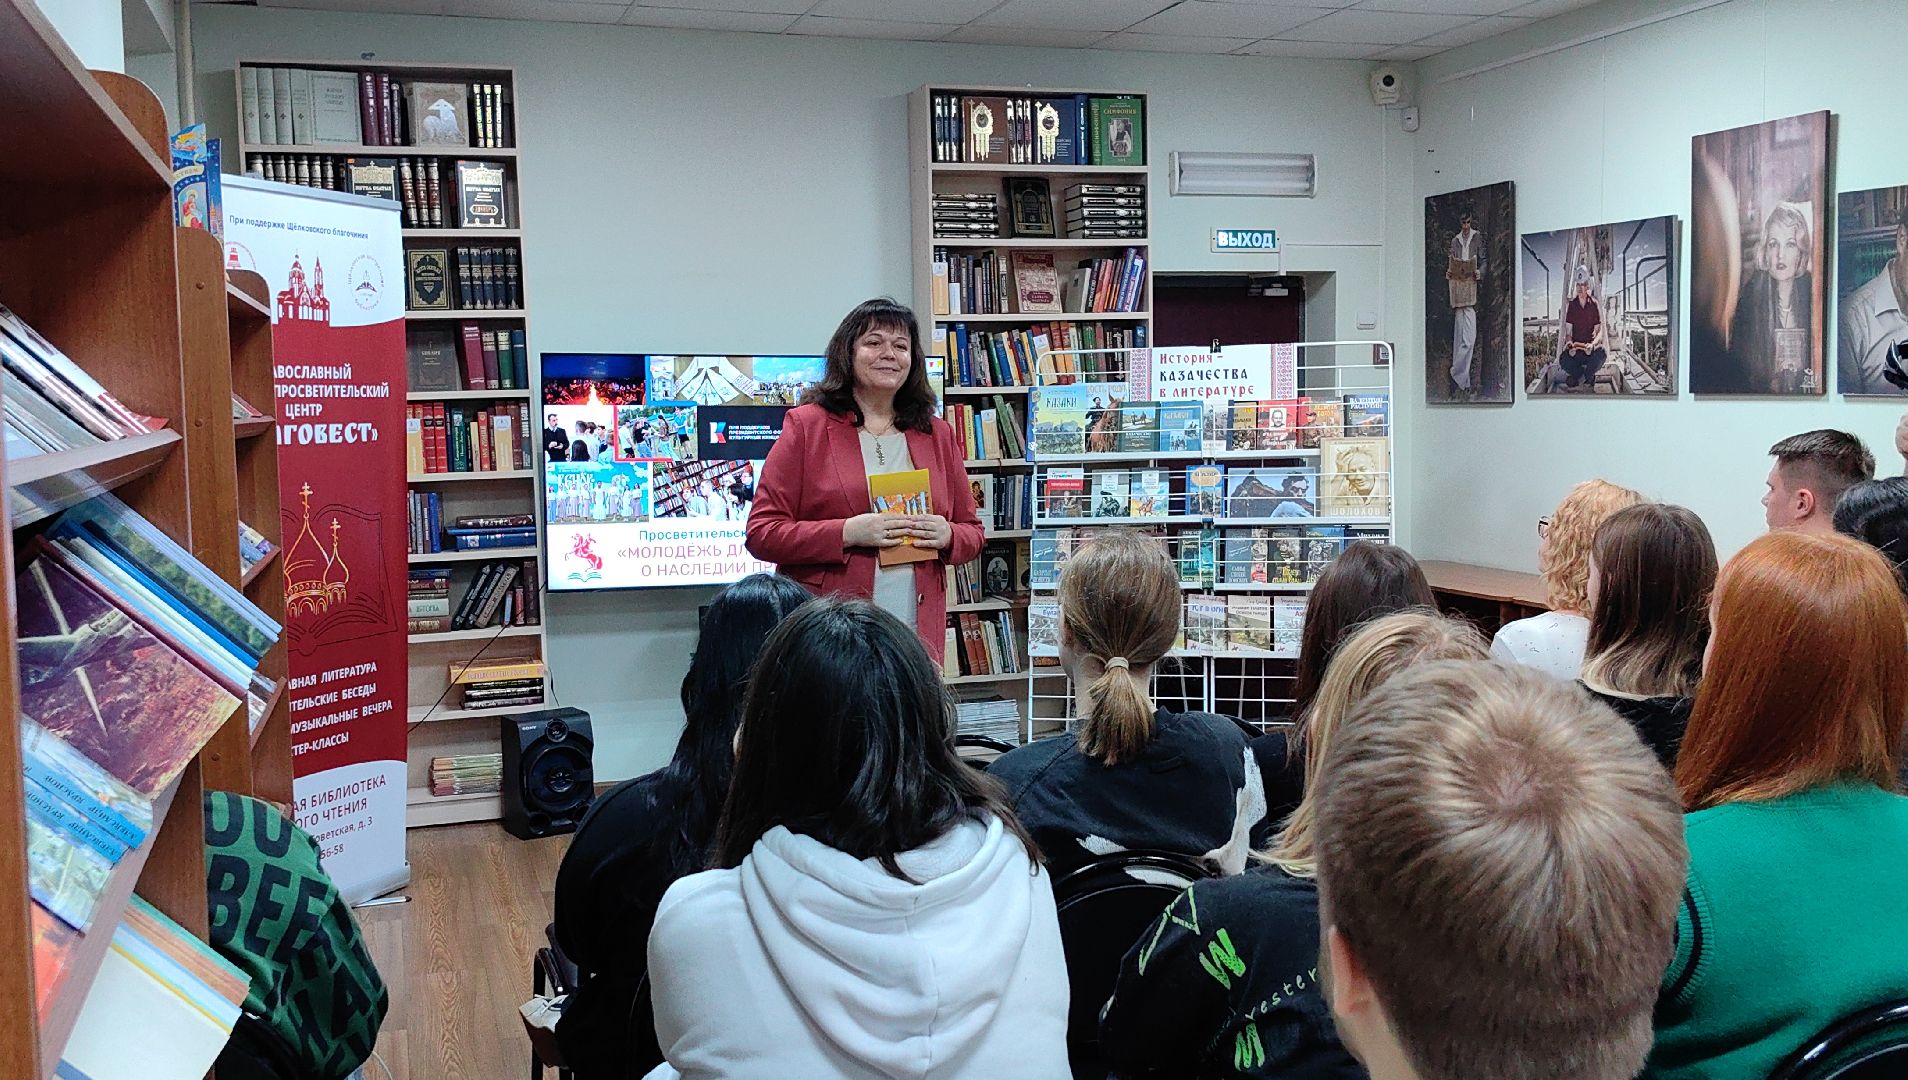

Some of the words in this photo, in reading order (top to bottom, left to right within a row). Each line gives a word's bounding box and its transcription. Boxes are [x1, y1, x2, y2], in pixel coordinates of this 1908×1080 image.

[229, 215, 244, 227] При
[246, 218, 285, 231] поддержке
[286, 221, 331, 236] Щёлковского
[332, 227, 368, 240] благочиния
[1218, 232, 1273, 248] ВЫХОД
[1160, 353, 1213, 365] История
[1160, 369, 1248, 381] КАЗАЧЕСТВА
[285, 403, 323, 419] ЦЕНТР
[1330, 507, 1381, 516] ШОЛОХОВ
[617, 543, 722, 559] «МОЛОДЁЖЬ
[642, 564, 651, 577] О
[657, 562, 746, 577] НАСЛЕДИИ
[321, 661, 377, 684] ЛИТЕРАТУРА
[342, 683, 377, 700] БЕСЕДЫ
[362, 699, 393, 718] ВЕЧЕРА
[311, 774, 387, 808] БИБЛИОТЕКА
[323, 797, 367, 821] ЧТЕНИЯ
[358, 820, 366, 832] д.
[368, 816, 373, 826] 3
